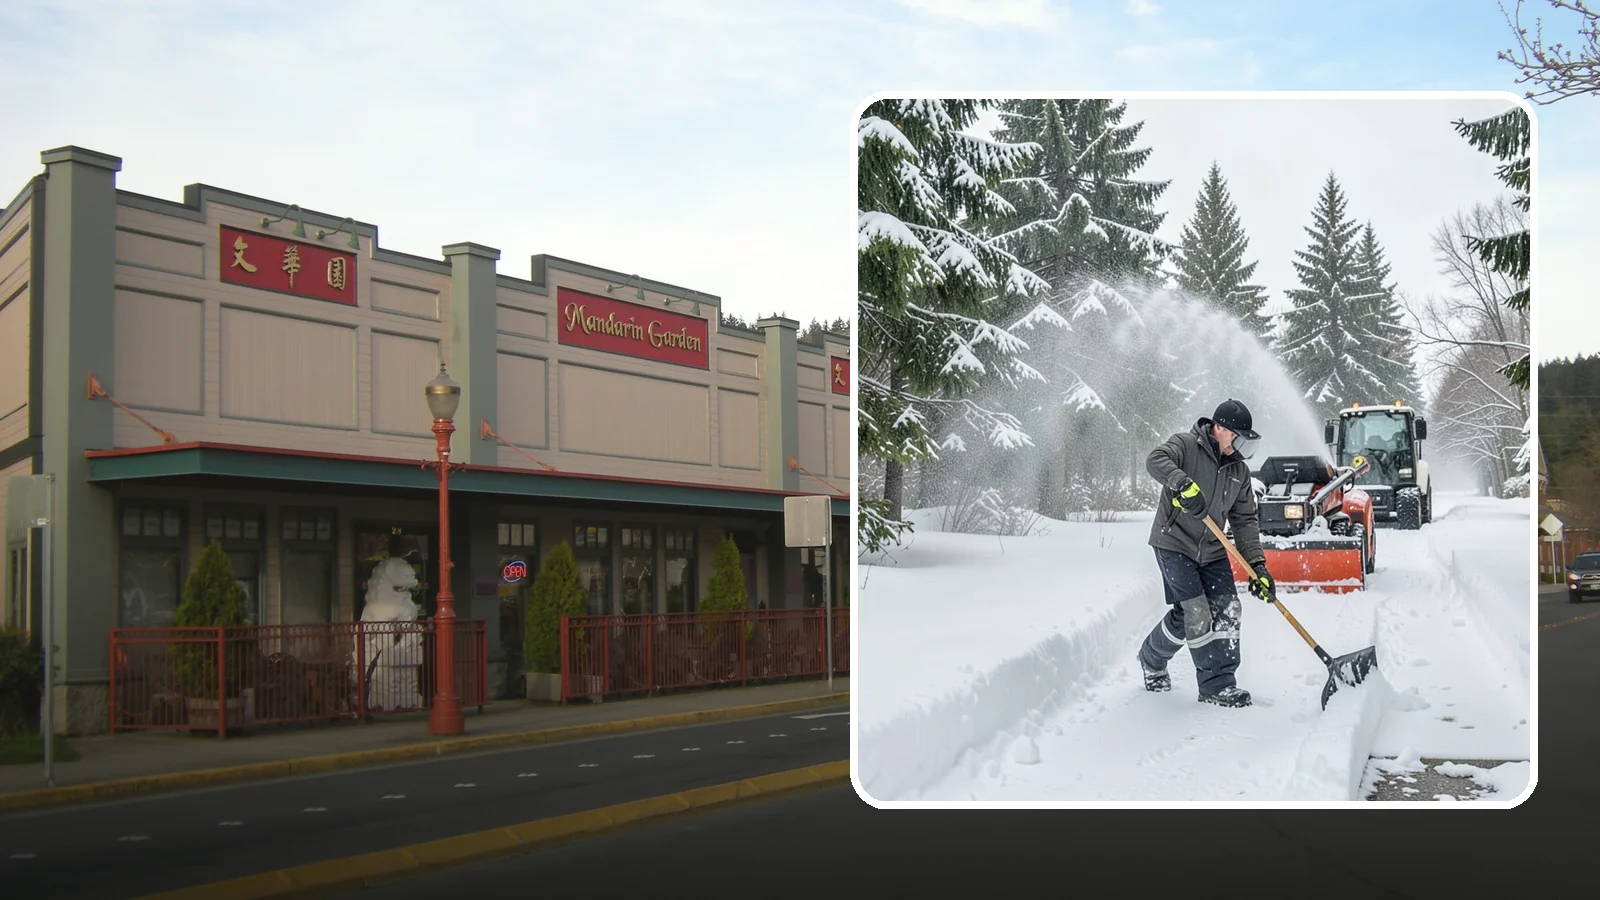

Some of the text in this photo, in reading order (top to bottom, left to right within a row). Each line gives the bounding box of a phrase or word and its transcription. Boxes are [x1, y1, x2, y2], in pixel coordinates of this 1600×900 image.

[231, 236, 346, 290] 文華園
[564, 302, 701, 352] Mandarin Garden
[503, 565, 527, 578] OPEN
